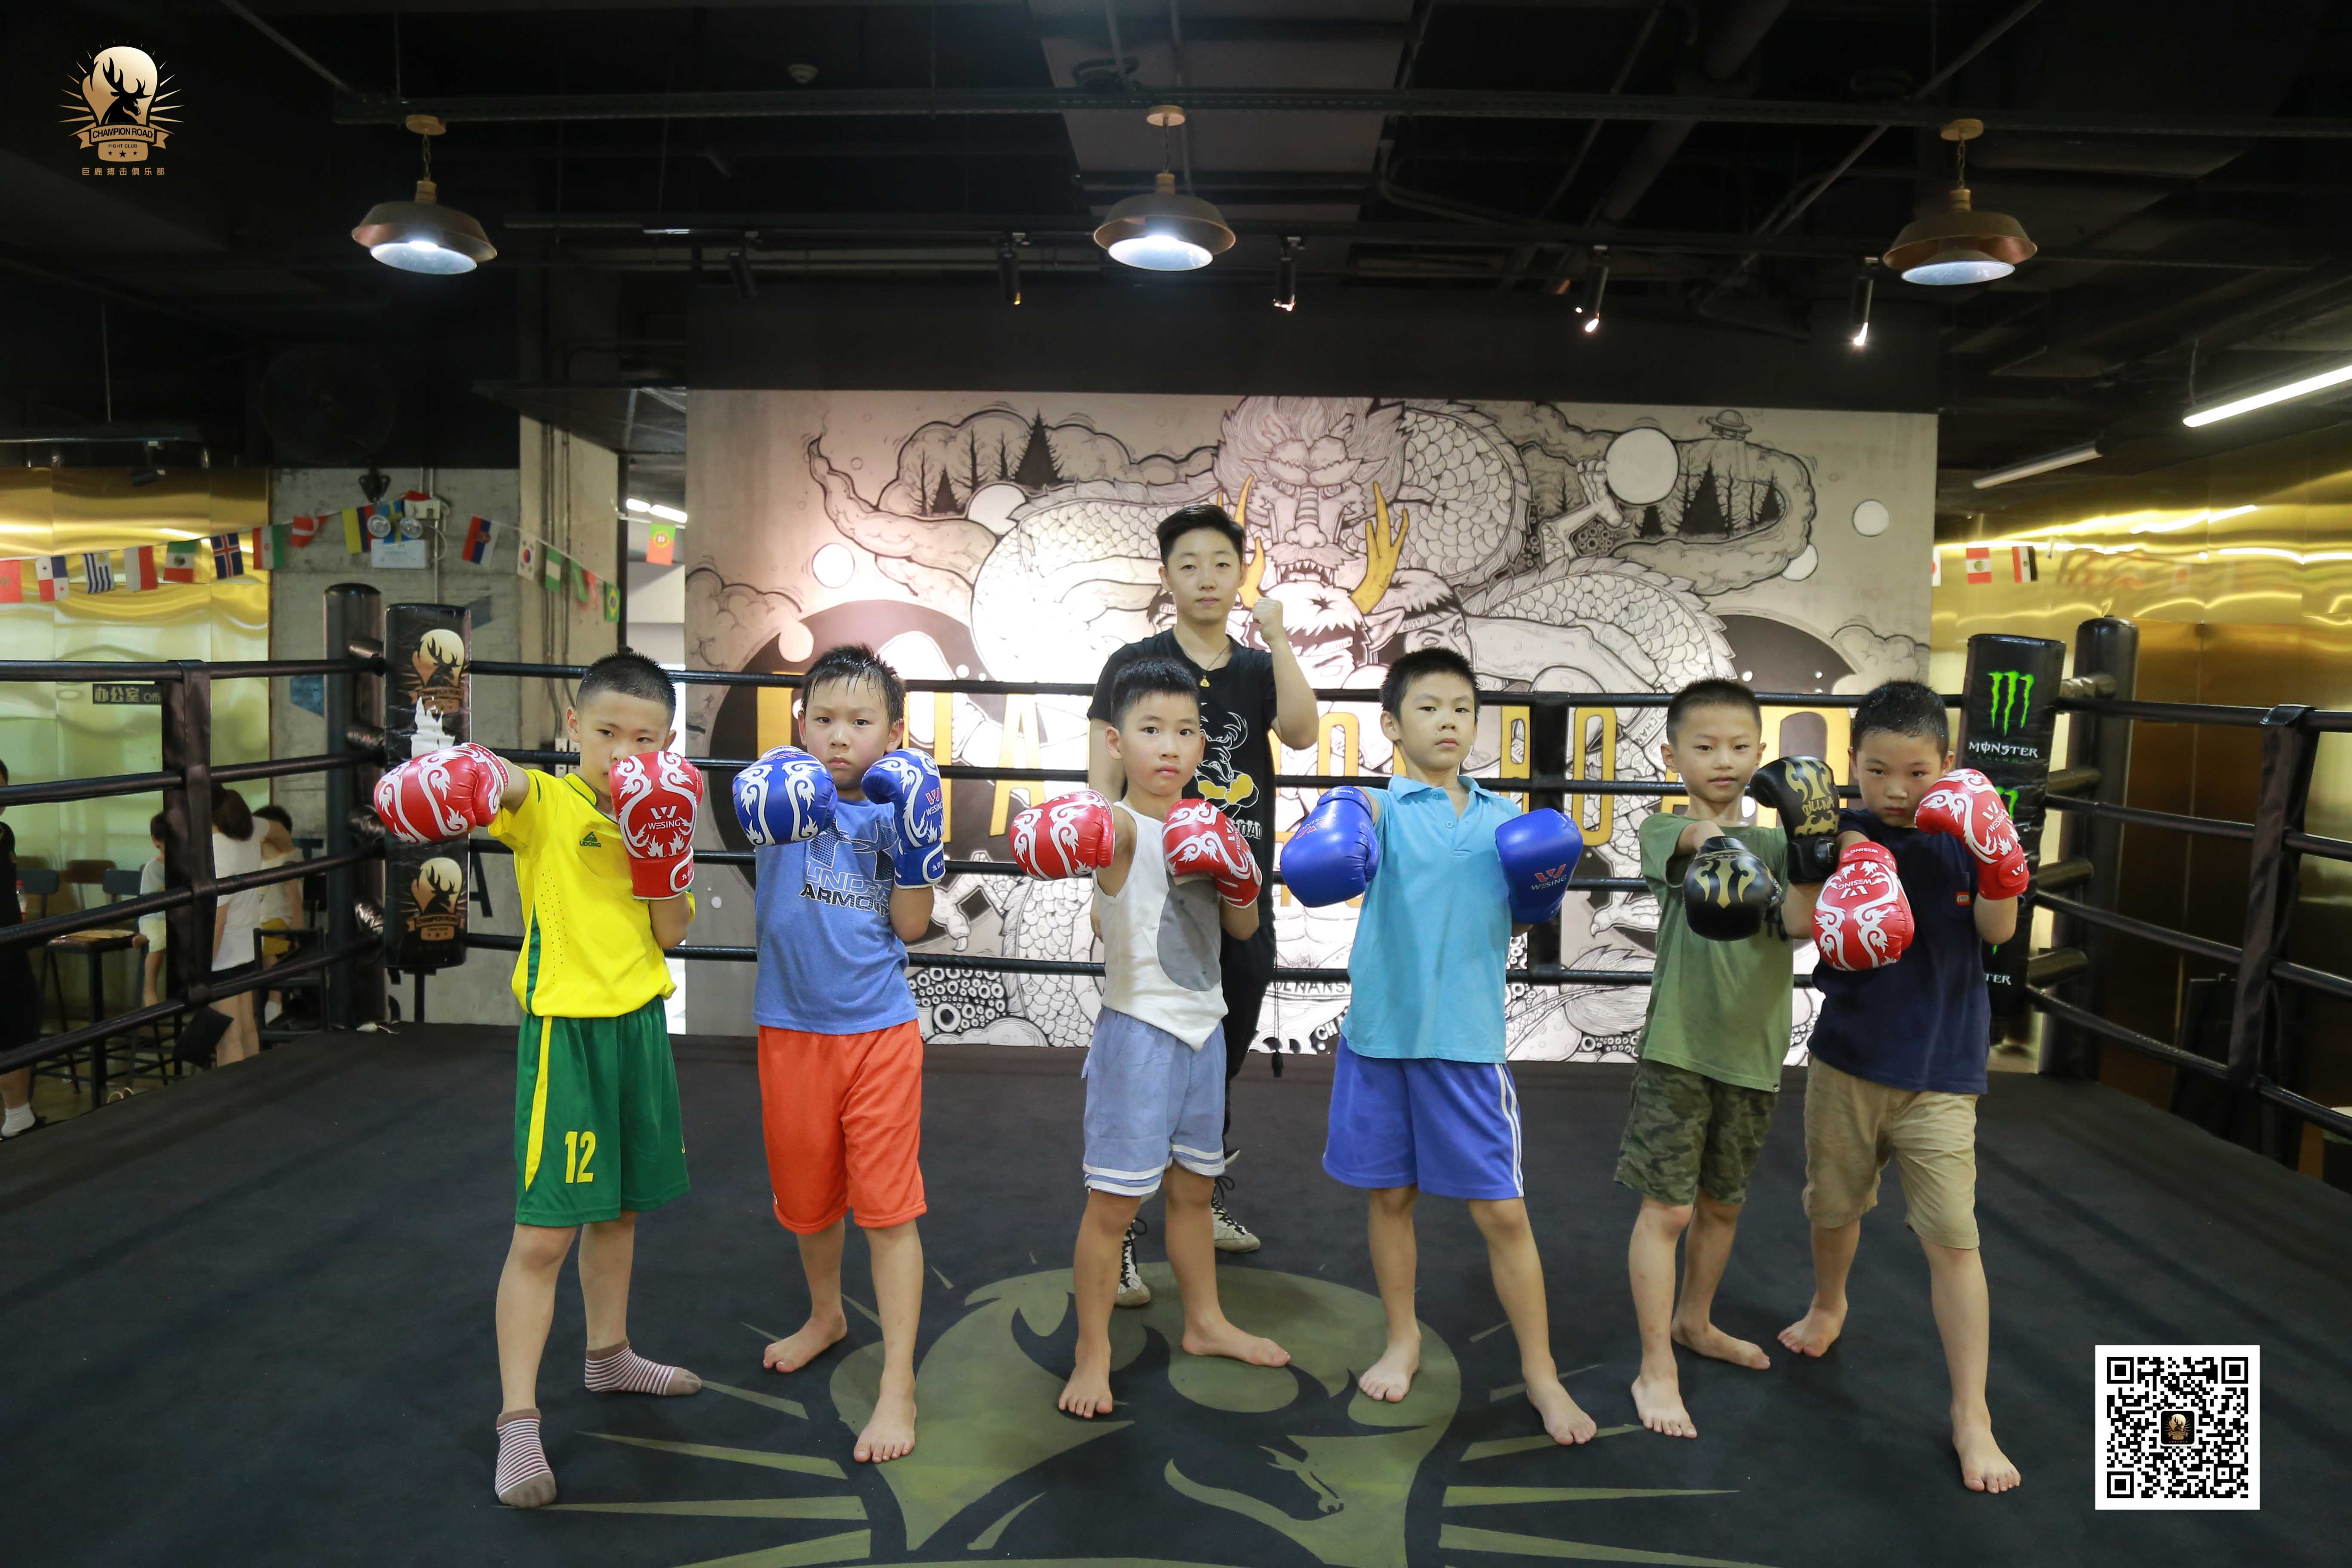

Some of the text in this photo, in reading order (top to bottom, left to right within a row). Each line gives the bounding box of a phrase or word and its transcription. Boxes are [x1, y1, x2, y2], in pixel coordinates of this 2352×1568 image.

[95, 687, 140, 702] 办公室
[648, 819, 680, 830] WESING
[1531, 875, 1567, 890] WESING
[1839, 879, 1871, 890] WESING
[564, 1131, 596, 1184] 12
